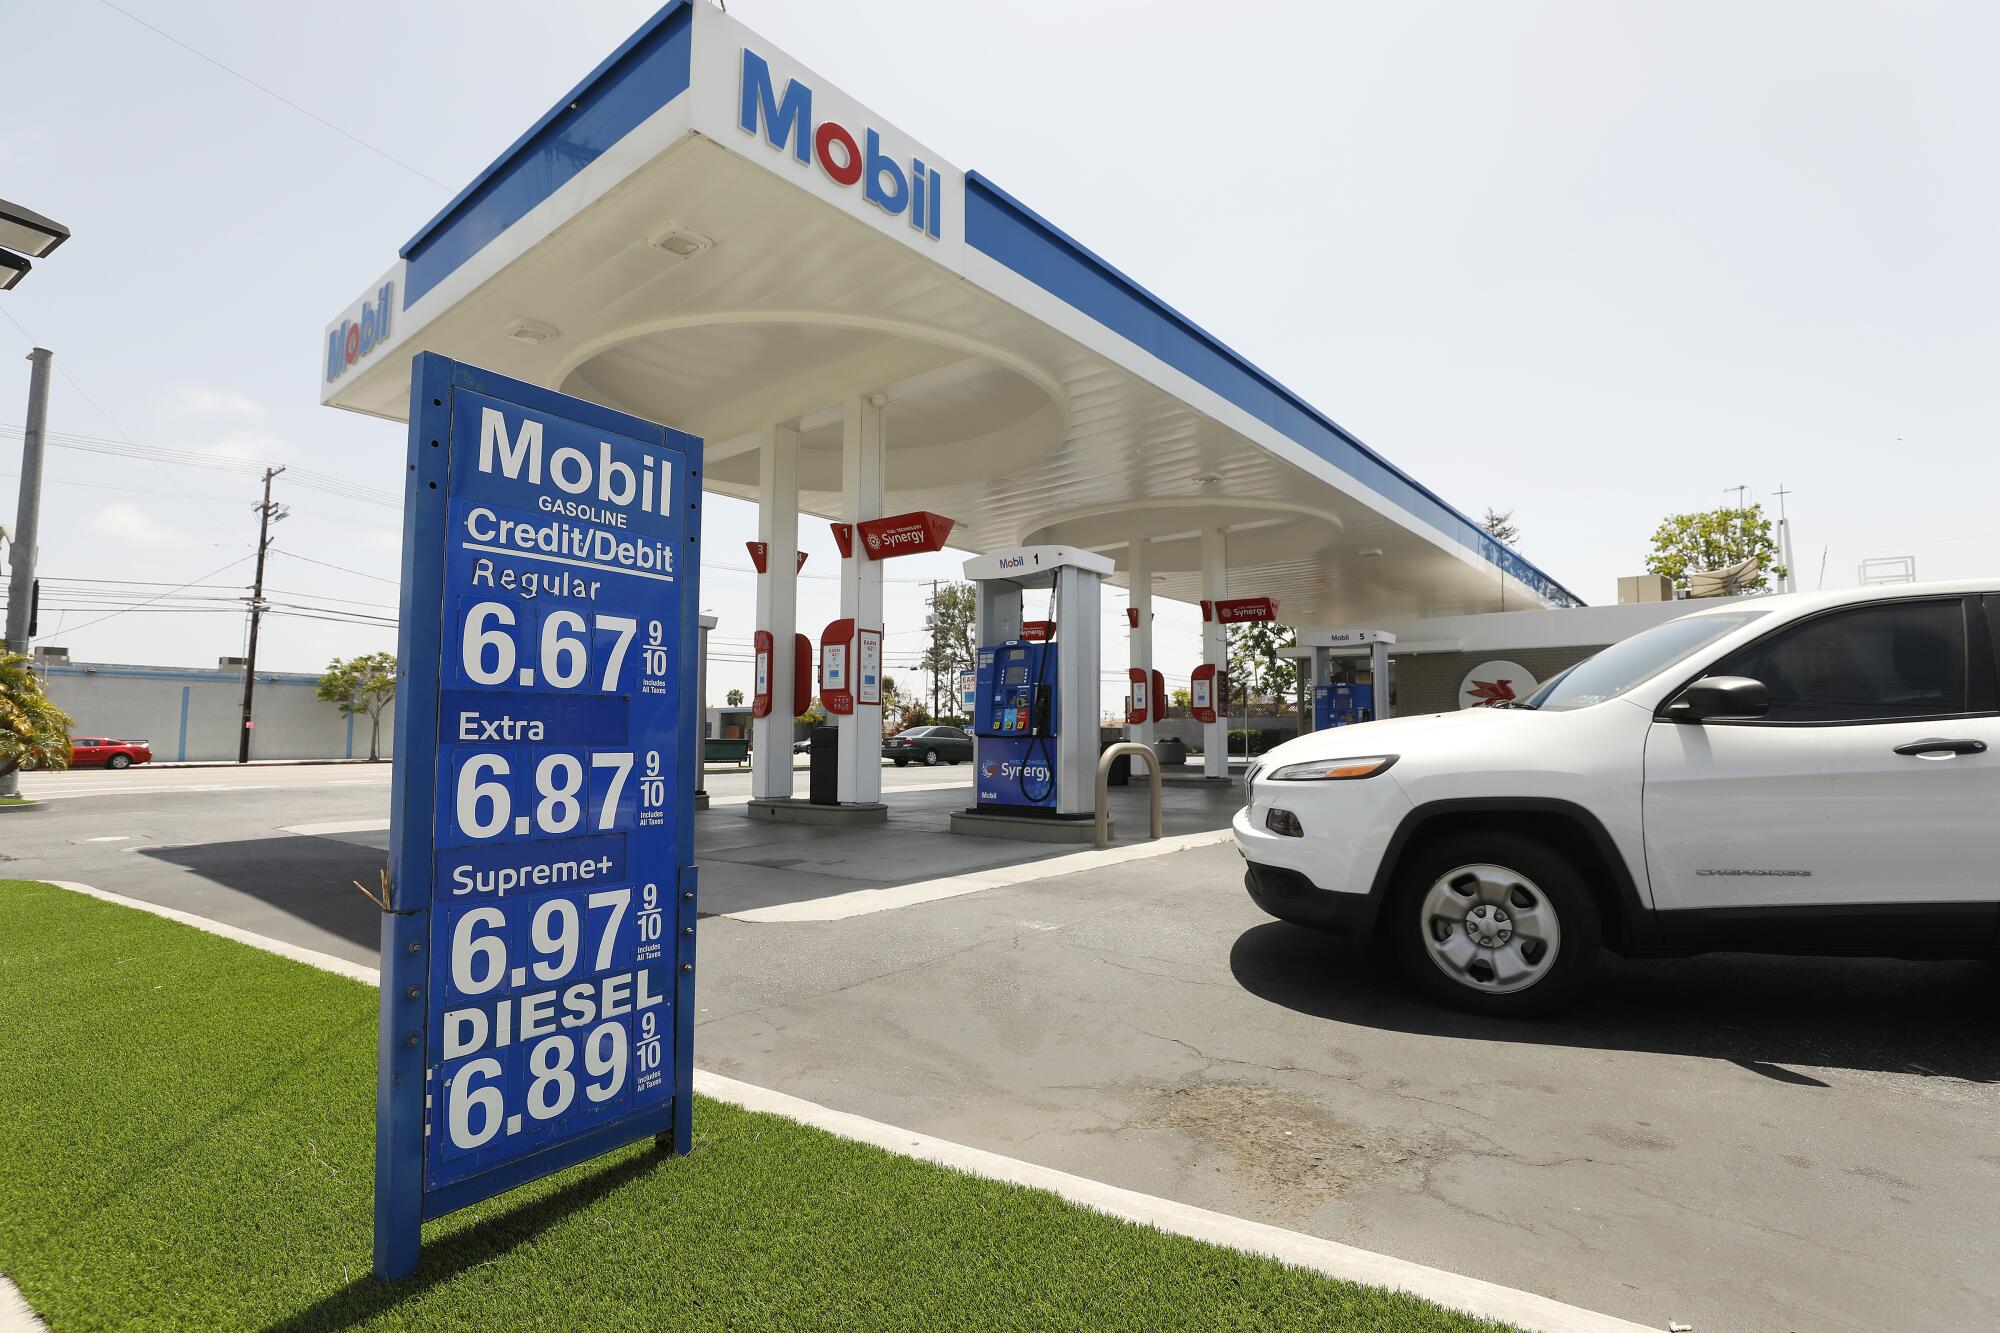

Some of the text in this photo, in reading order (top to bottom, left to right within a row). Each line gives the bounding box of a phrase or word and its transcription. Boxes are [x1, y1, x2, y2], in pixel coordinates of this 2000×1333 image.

[739, 46, 941, 241] Mobil
[326, 281, 393, 383] Mobil
[479, 406, 672, 517] Mobil
[538, 496, 628, 529] GASOLINE
[467, 508, 674, 573] Credit/Debit
[843, 527, 848, 538] 1
[881, 530, 924, 547] Synergy
[758, 544, 764, 554] 3
[1000, 553, 1039, 569] Mobil 1
[472, 559, 601, 600] Regular
[1233, 607, 1267, 617] Synergy
[648, 620, 662, 646] 9
[462, 601, 637, 692] 6.67
[643, 650, 667, 676] 10
[643, 679, 666, 687] Includes
[651, 687, 666, 695] Taxes
[963, 676, 975, 684] EAR
[459, 711, 545, 741] Extra
[646, 750, 660, 777] 9
[456, 753, 634, 838] 6.87
[640, 781, 665, 807] 10
[640, 811, 664, 819] Includes
[649, 818, 664, 826] Taxes
[452, 855, 613, 896] Supreme+
[1695, 869, 1813, 877] CHEROKEE
[643, 883, 657, 910] 9
[637, 913, 662, 942] 10
[451, 888, 631, 995] 6.97
[637, 943, 661, 954] Includes
[637, 951, 661, 961] All Taxes
[443, 969, 663, 1061] DIESEL
[641, 1011, 656, 1039] 9
[636, 1041, 661, 1072] 10
[448, 1021, 628, 1149] 6.89
[637, 1071, 661, 1084] Includes
[637, 1077, 662, 1092] All Taxes
